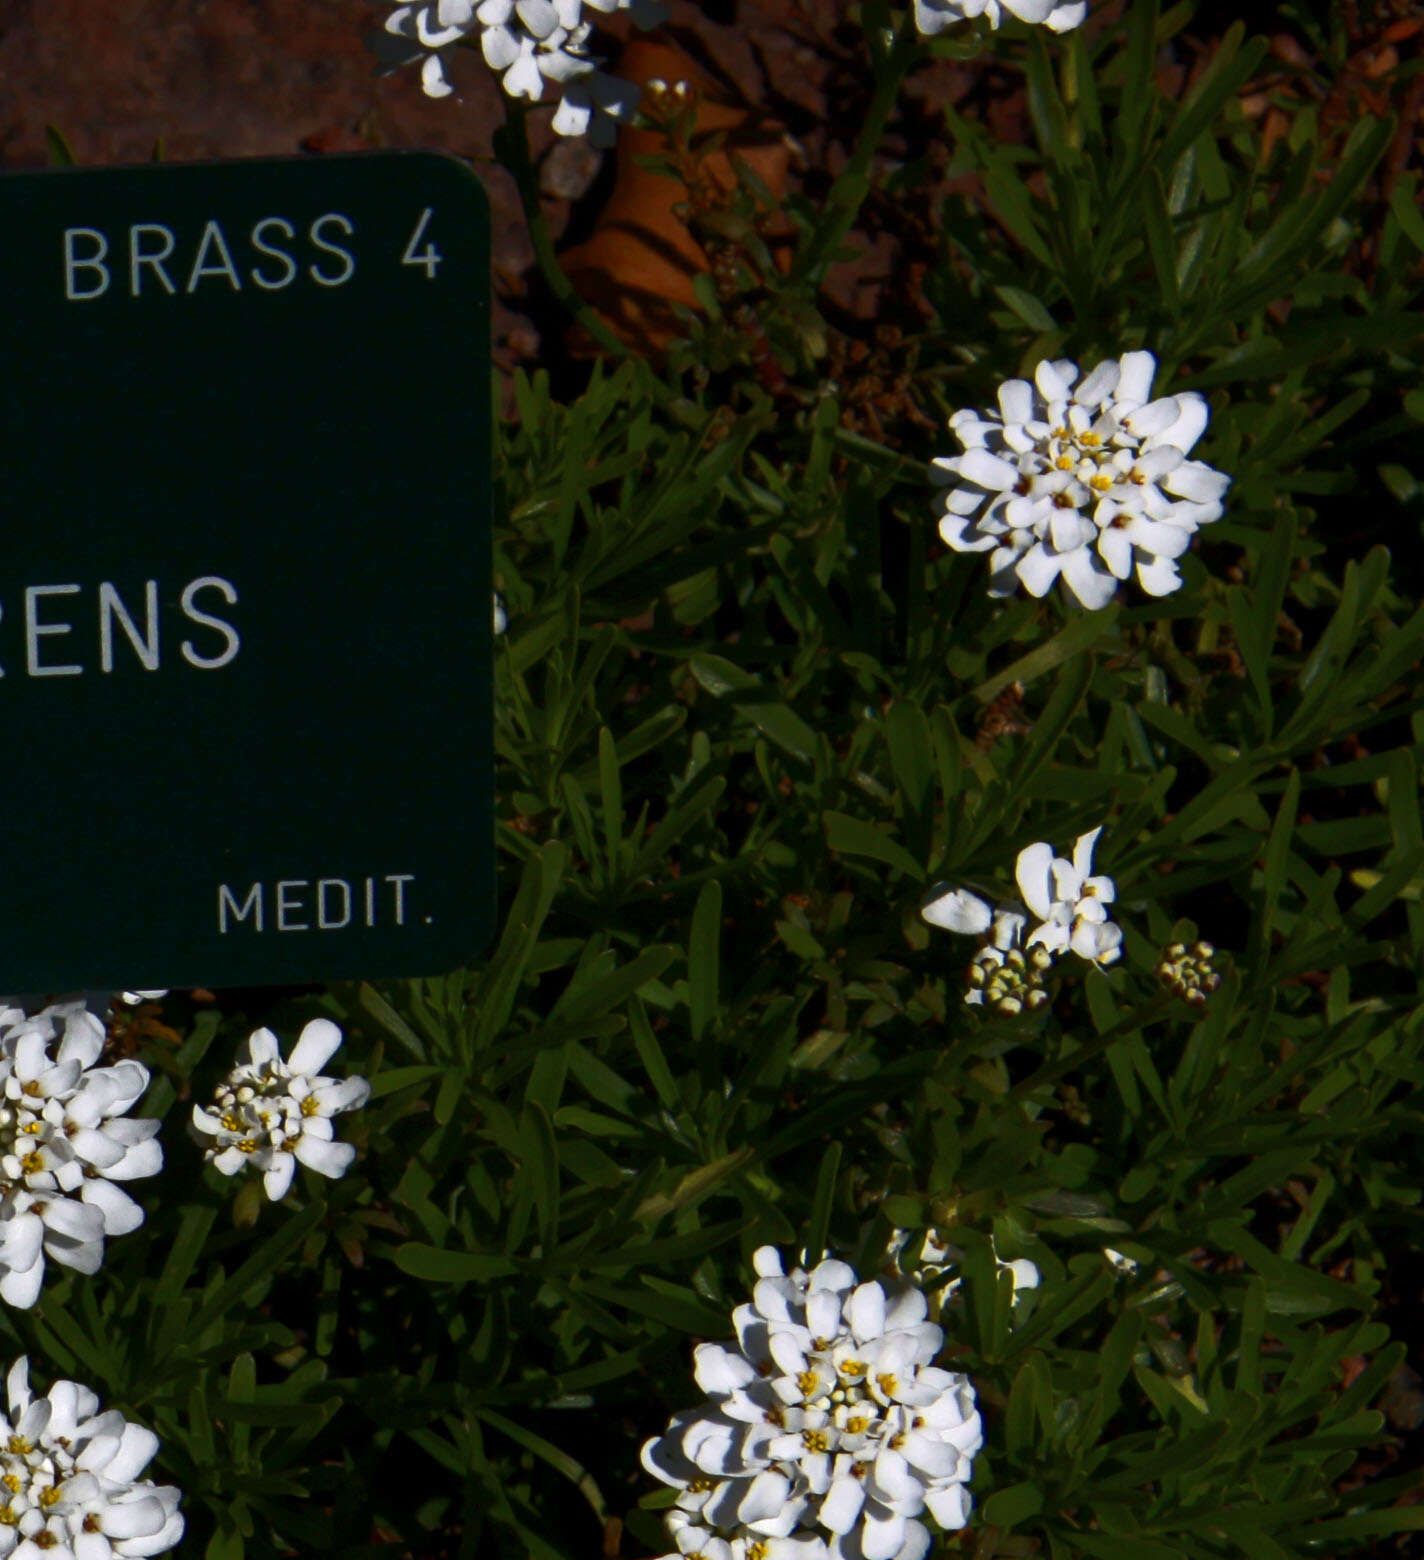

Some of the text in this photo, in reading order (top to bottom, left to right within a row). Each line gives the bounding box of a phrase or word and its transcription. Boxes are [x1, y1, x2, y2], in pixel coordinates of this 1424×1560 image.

[63, 208, 441, 300] BRASS 4
[218, 873, 436, 934] MEDIT.
